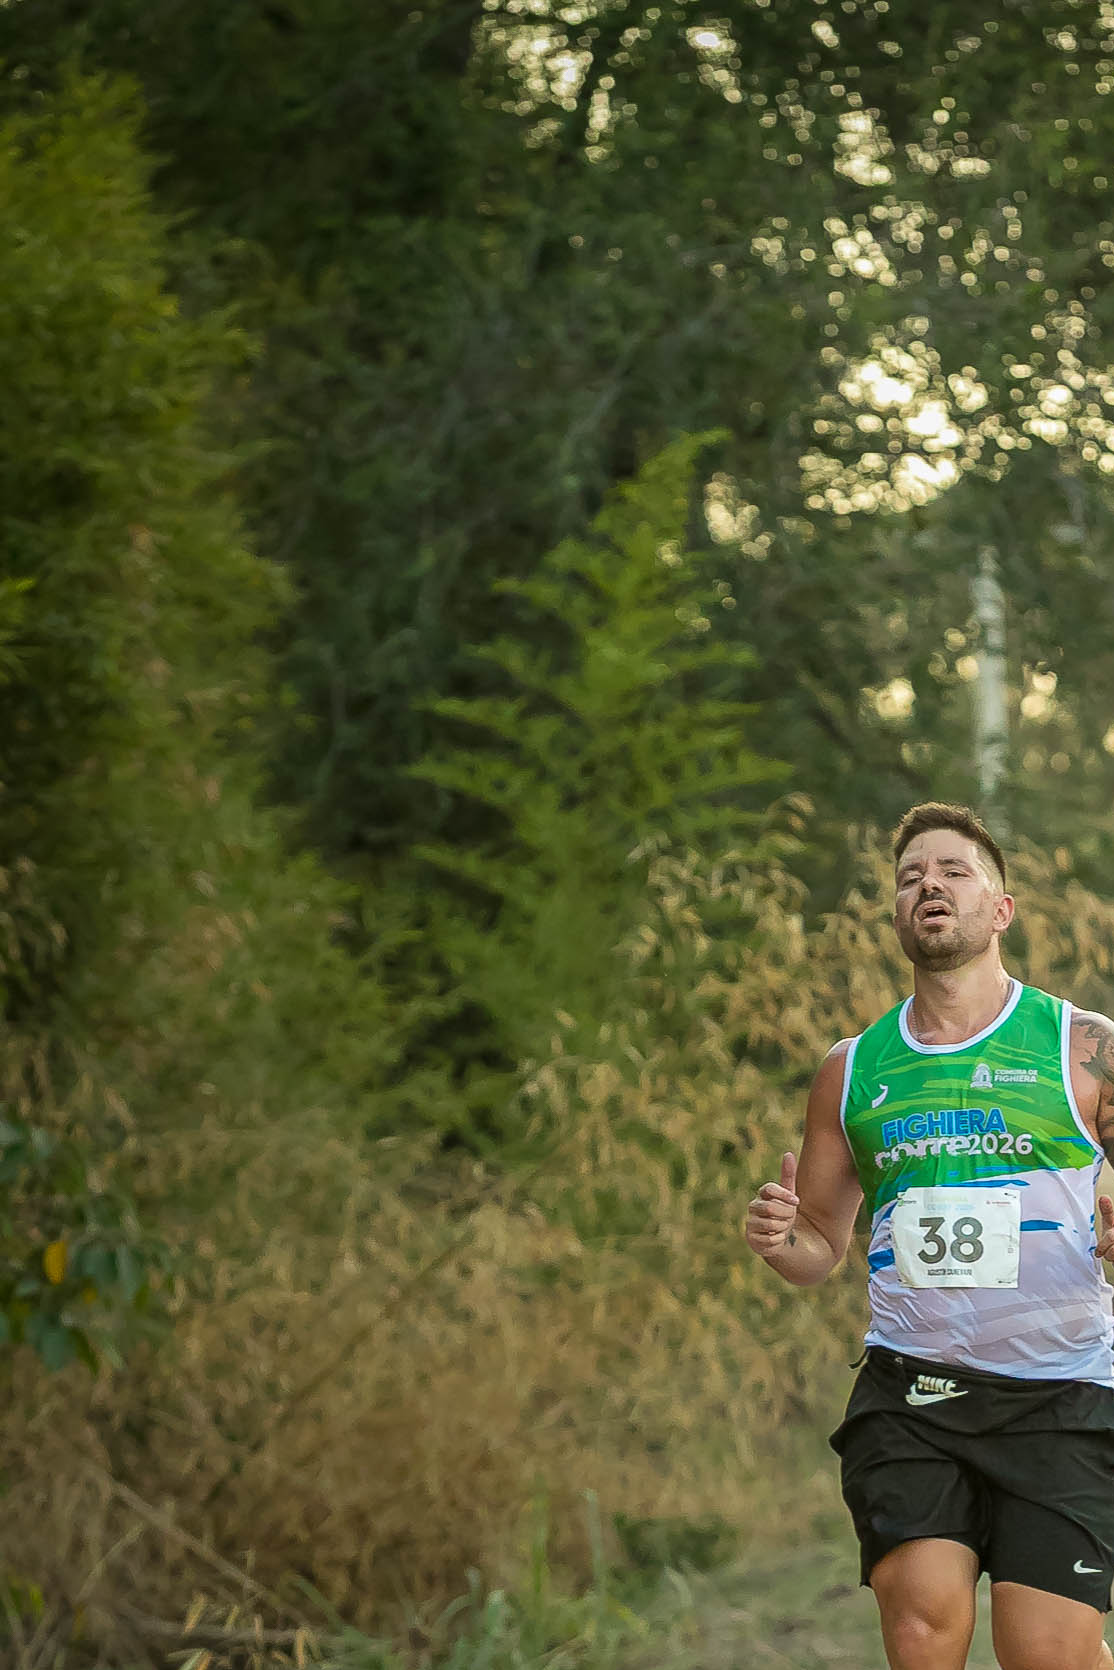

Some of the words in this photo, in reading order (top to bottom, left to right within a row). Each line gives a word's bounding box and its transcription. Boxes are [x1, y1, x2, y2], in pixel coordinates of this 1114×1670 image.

[995, 1075, 1037, 1083] FIGHIERA
[882, 1107, 1007, 1148] FIGHIERA
[917, 1216, 984, 1264] 38
[917, 1374, 959, 1394] NIKE
